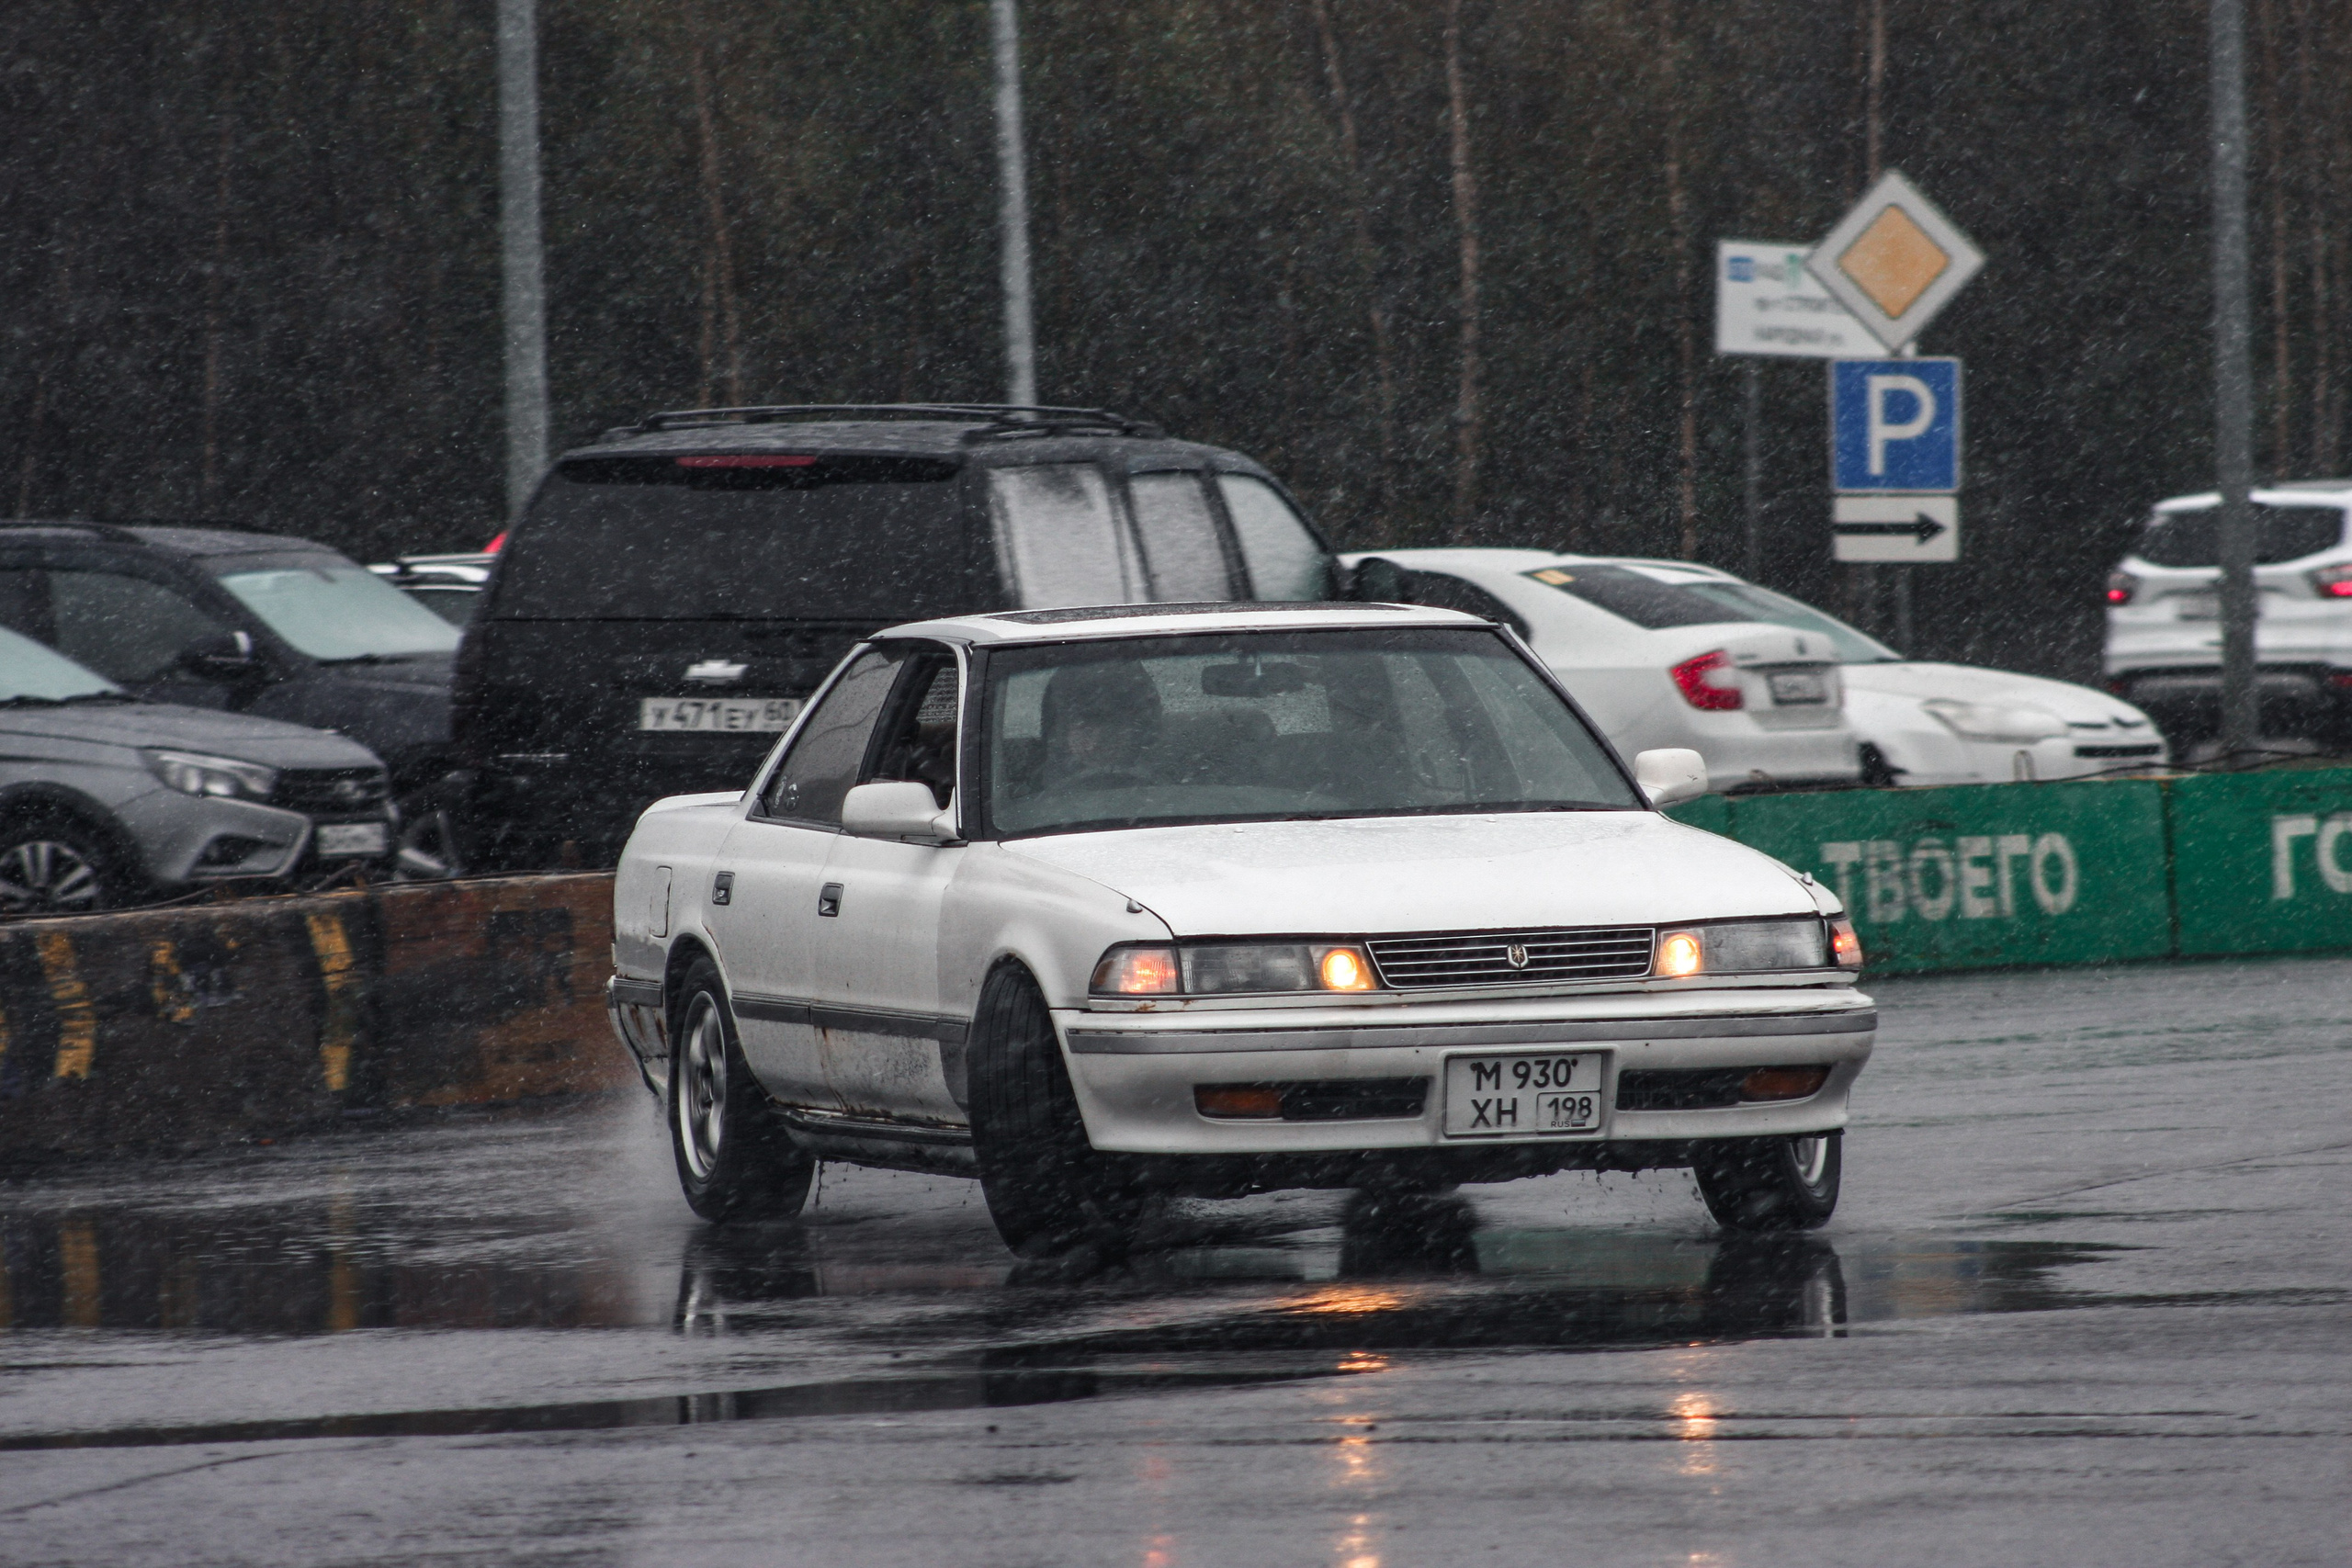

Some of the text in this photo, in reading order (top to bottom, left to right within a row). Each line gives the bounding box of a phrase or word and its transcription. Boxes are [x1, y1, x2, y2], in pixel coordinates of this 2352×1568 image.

[1866, 374, 1937, 477] P
[1820, 832, 2078, 922] ТВОЕГО
[1512, 1058, 1573, 1089] 930
[1547, 1096, 1592, 1120] 198
[1551, 1120, 1571, 1128] RUS
